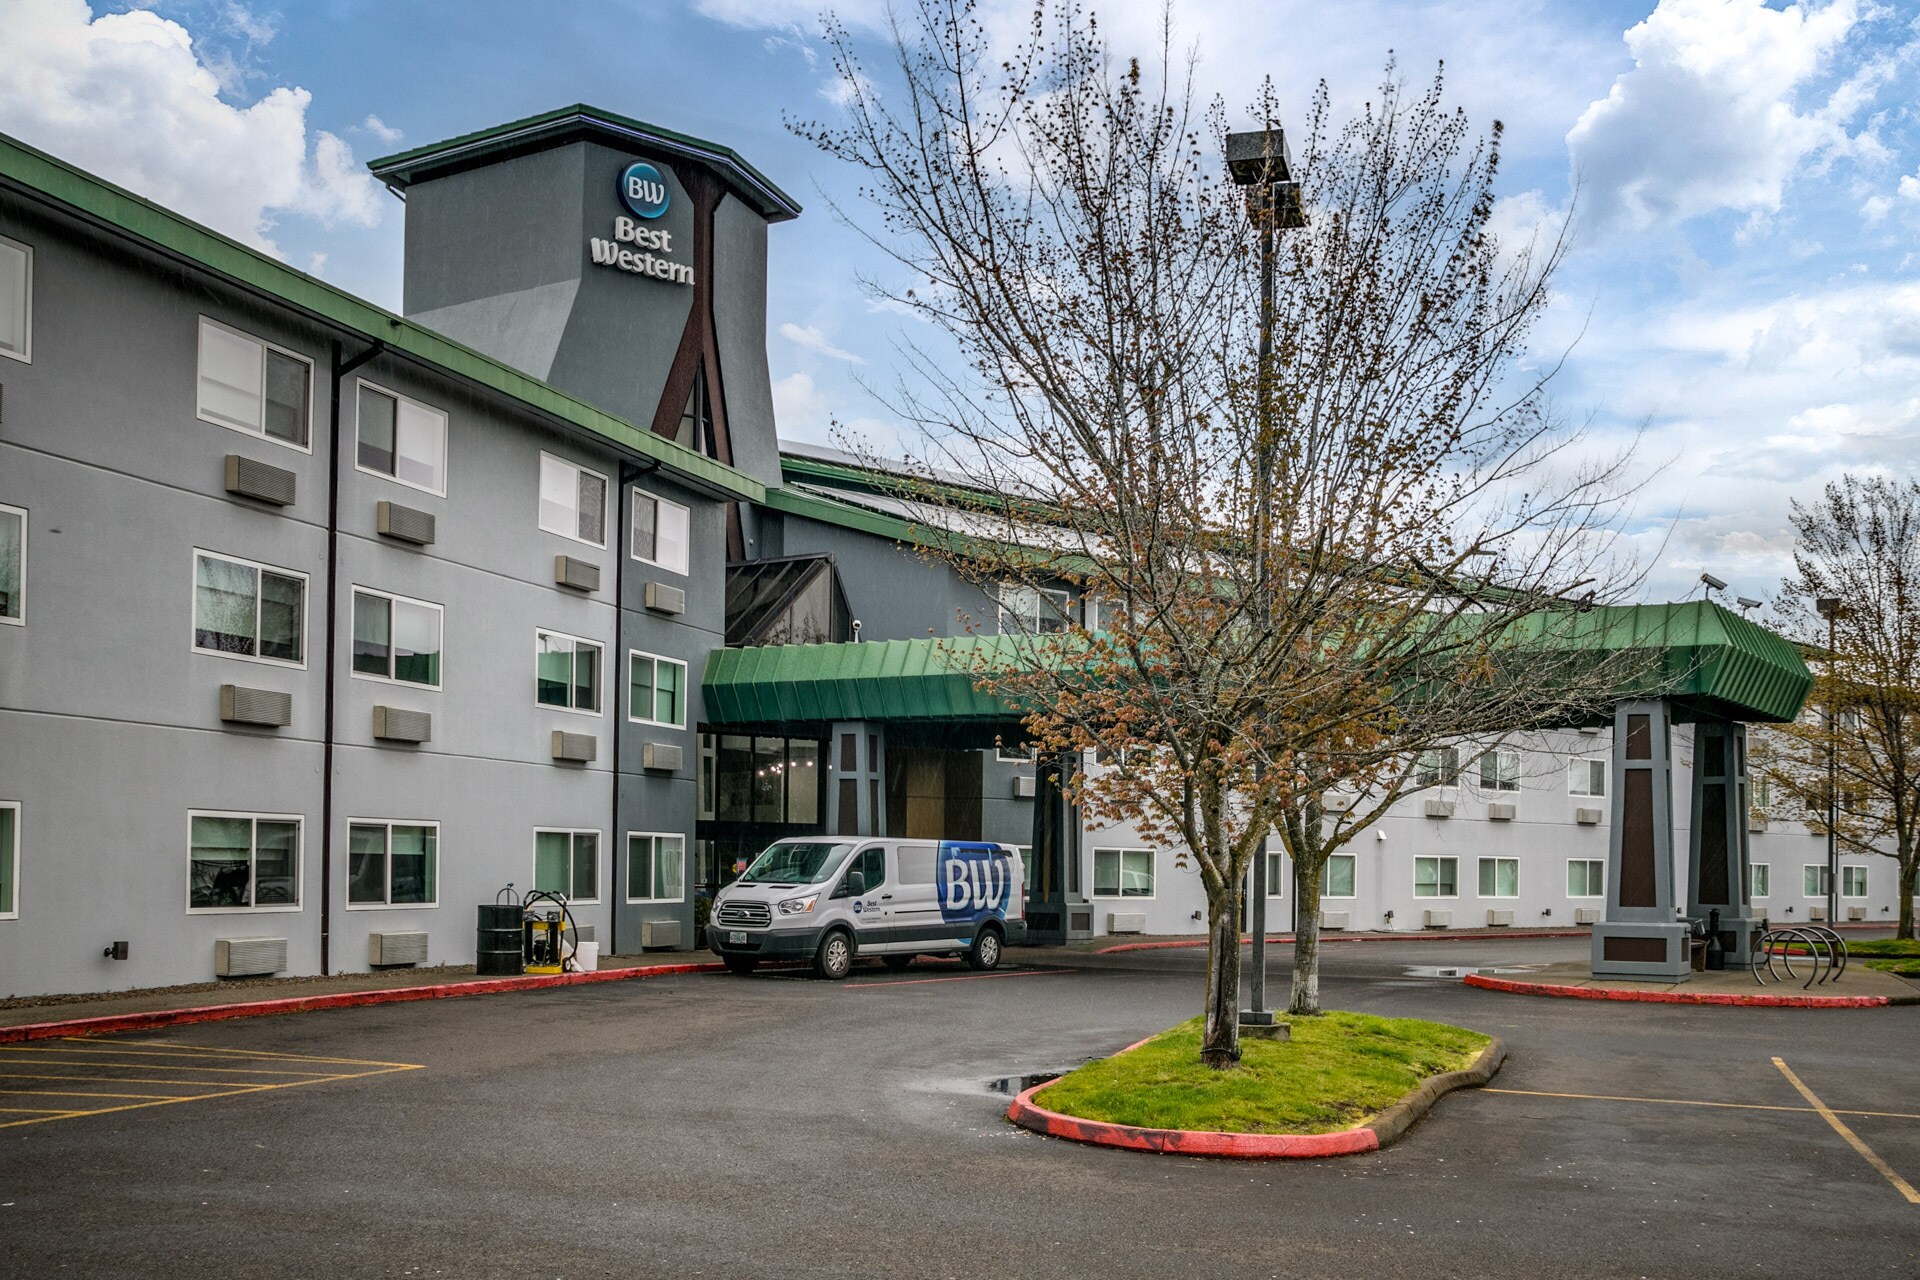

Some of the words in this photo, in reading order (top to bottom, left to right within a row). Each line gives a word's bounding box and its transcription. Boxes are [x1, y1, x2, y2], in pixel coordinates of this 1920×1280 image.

[628, 176, 665, 205] BW
[615, 216, 673, 253] Best
[590, 237, 696, 286] Western
[945, 858, 1005, 910] BW
